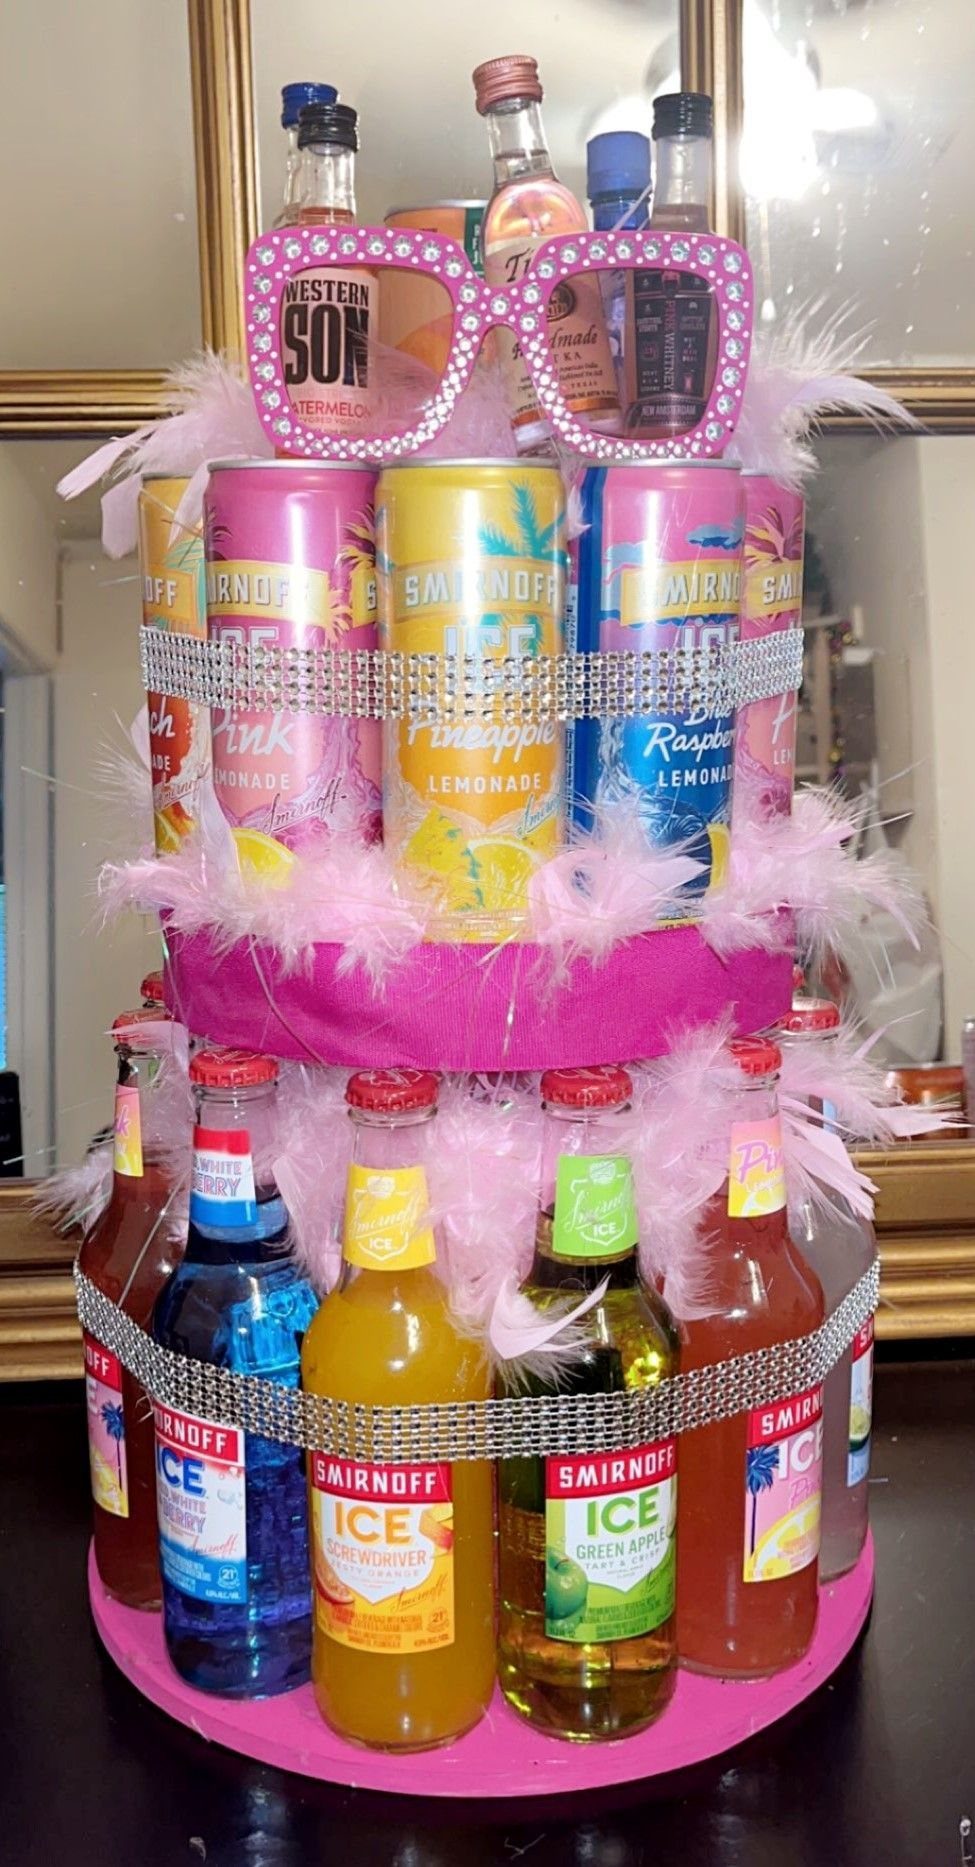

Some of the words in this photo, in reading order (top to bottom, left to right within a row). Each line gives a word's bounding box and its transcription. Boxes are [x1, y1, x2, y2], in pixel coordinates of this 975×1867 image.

[285, 279, 370, 306] WESTERN
[284, 303, 370, 387] SON
[664, 333, 676, 390] WHITNEY
[290, 401, 371, 418] ATERMELON
[145, 576, 177, 607] OFF
[408, 700, 558, 764] Pineapple
[428, 773, 541, 794] LEMONADE
[115, 1105, 131, 1139] k
[199, 1157, 241, 1175] WHITE
[195, 1172, 241, 1197] ERRY
[369, 1238, 392, 1250] ICE
[593, 1223, 616, 1236] ICE
[317, 1460, 437, 1495] SMIRNOFF
[559, 1445, 673, 1489] SMIRNOFF
[334, 1501, 411, 1544] ICE
[587, 1486, 659, 1536] ICE
[327, 1538, 426, 1568] SCREWDRIVER
[576, 1542, 624, 1560] GREEN
[628, 1527, 665, 1554] APPLE
[331, 1559, 362, 1575] ZESTY
[368, 1567, 419, 1578] ORANGE
